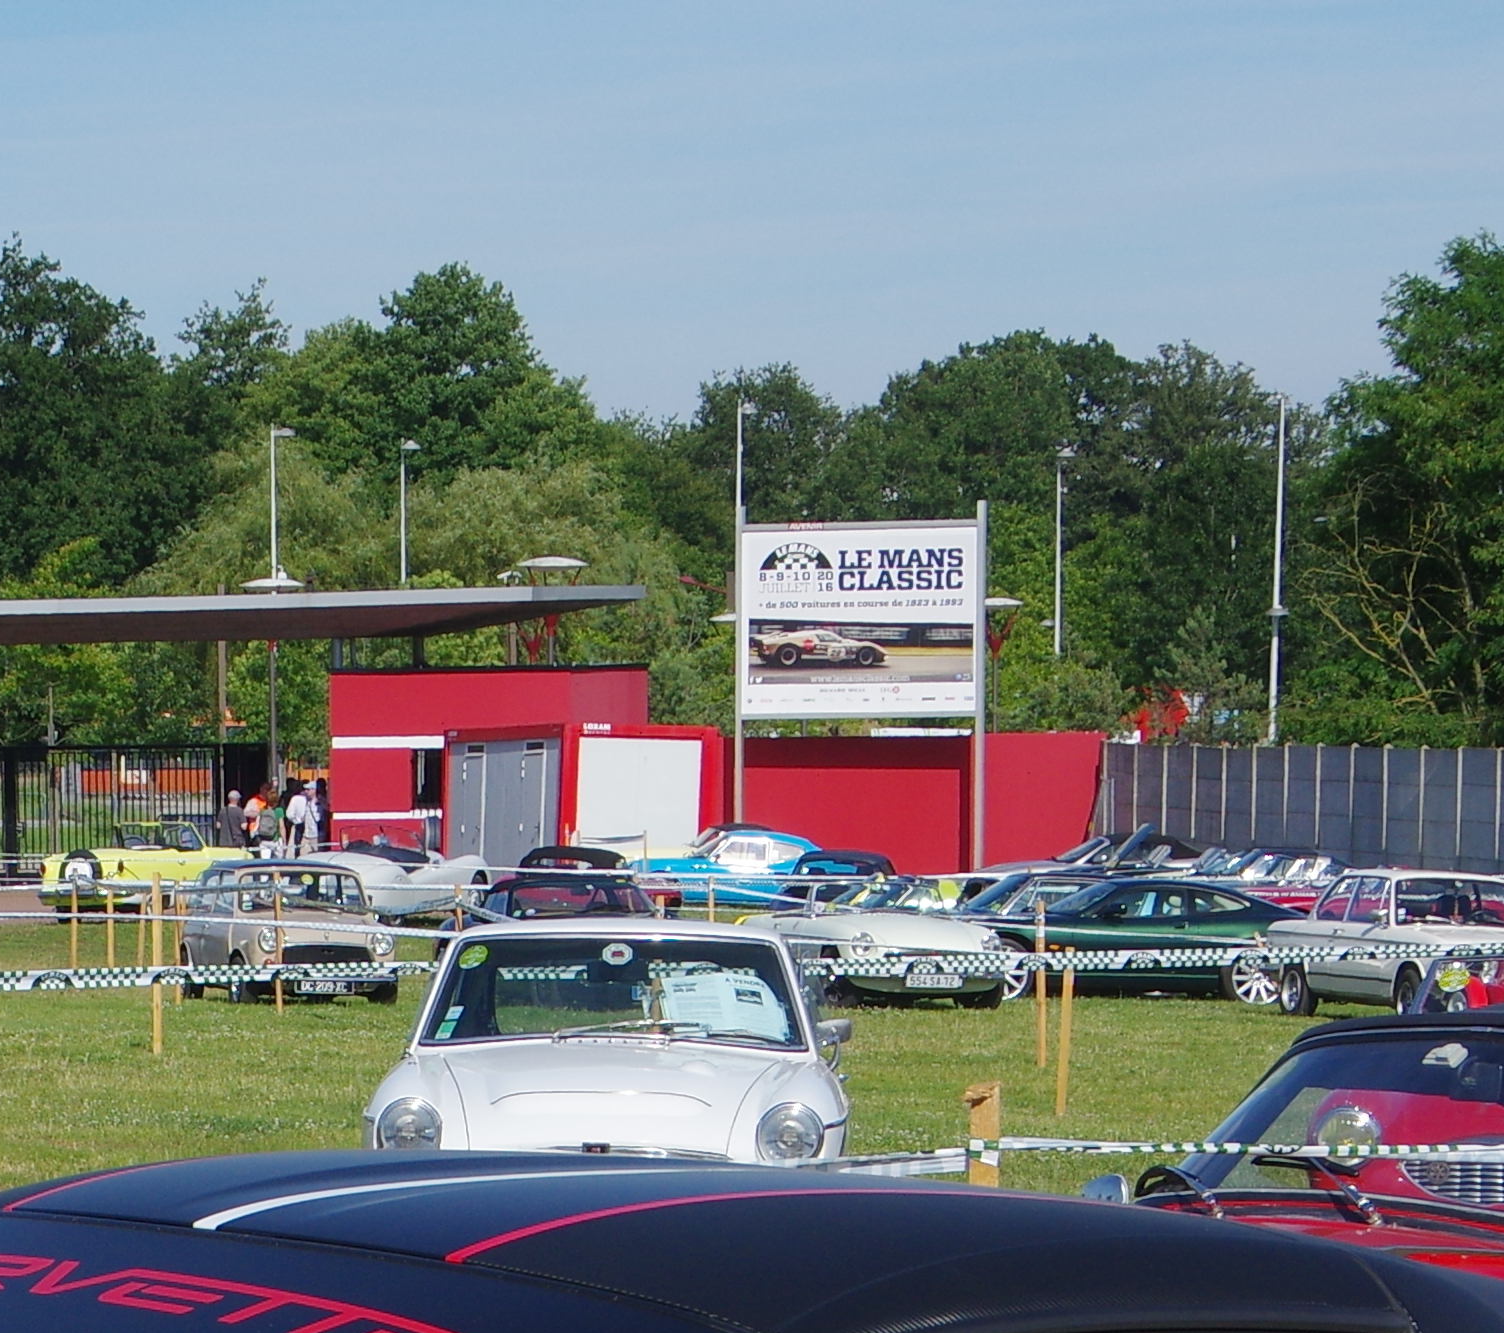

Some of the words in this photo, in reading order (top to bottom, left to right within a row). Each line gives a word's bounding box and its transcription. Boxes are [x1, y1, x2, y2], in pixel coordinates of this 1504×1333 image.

[790, 543, 821, 558] MANS
[838, 549, 873, 570] LE
[878, 548, 964, 569] MANS
[817, 571, 835, 581] 20
[838, 568, 964, 592] CLASSIC
[758, 582, 811, 595] JUILLET
[817, 581, 835, 593] 16
[765, 601, 777, 609] de
[779, 600, 799, 609] 500
[801, 600, 841, 609] voitures
[843, 601, 855, 609] en
[857, 600, 890, 608] course
[891, 599, 904, 608] de
[939, 597, 965, 607] 1993
[809, 673, 911, 683] www.lemansclassic.com
[909, 975, 928, 986] 554
[929, 975, 941, 987] SA
[943, 976, 955, 987] 72
